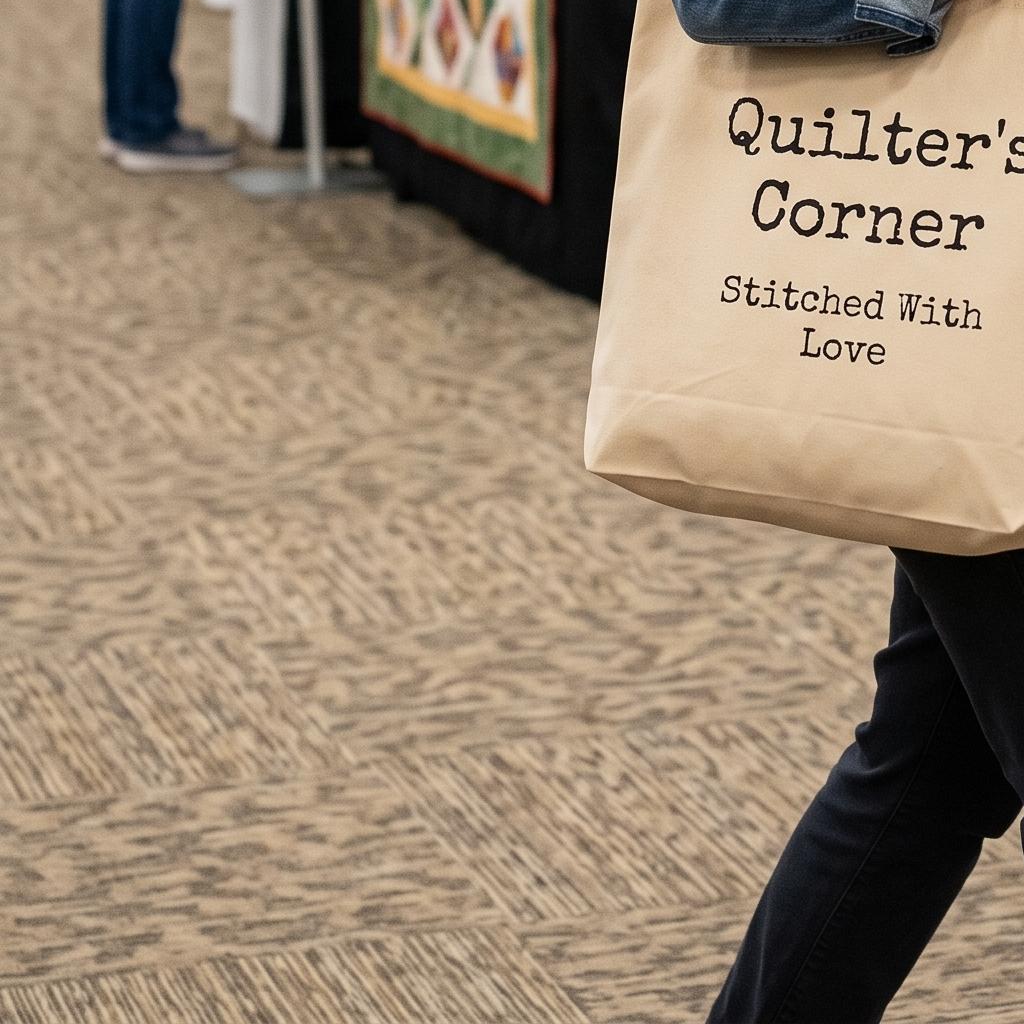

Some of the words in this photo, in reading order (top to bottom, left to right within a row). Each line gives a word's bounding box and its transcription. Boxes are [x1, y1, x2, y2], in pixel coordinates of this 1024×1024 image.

[751, 179, 985, 251] Corner
[720, 275, 884, 321] Stitched
[898, 293, 983, 330] With
[799, 327, 887, 366] Love
